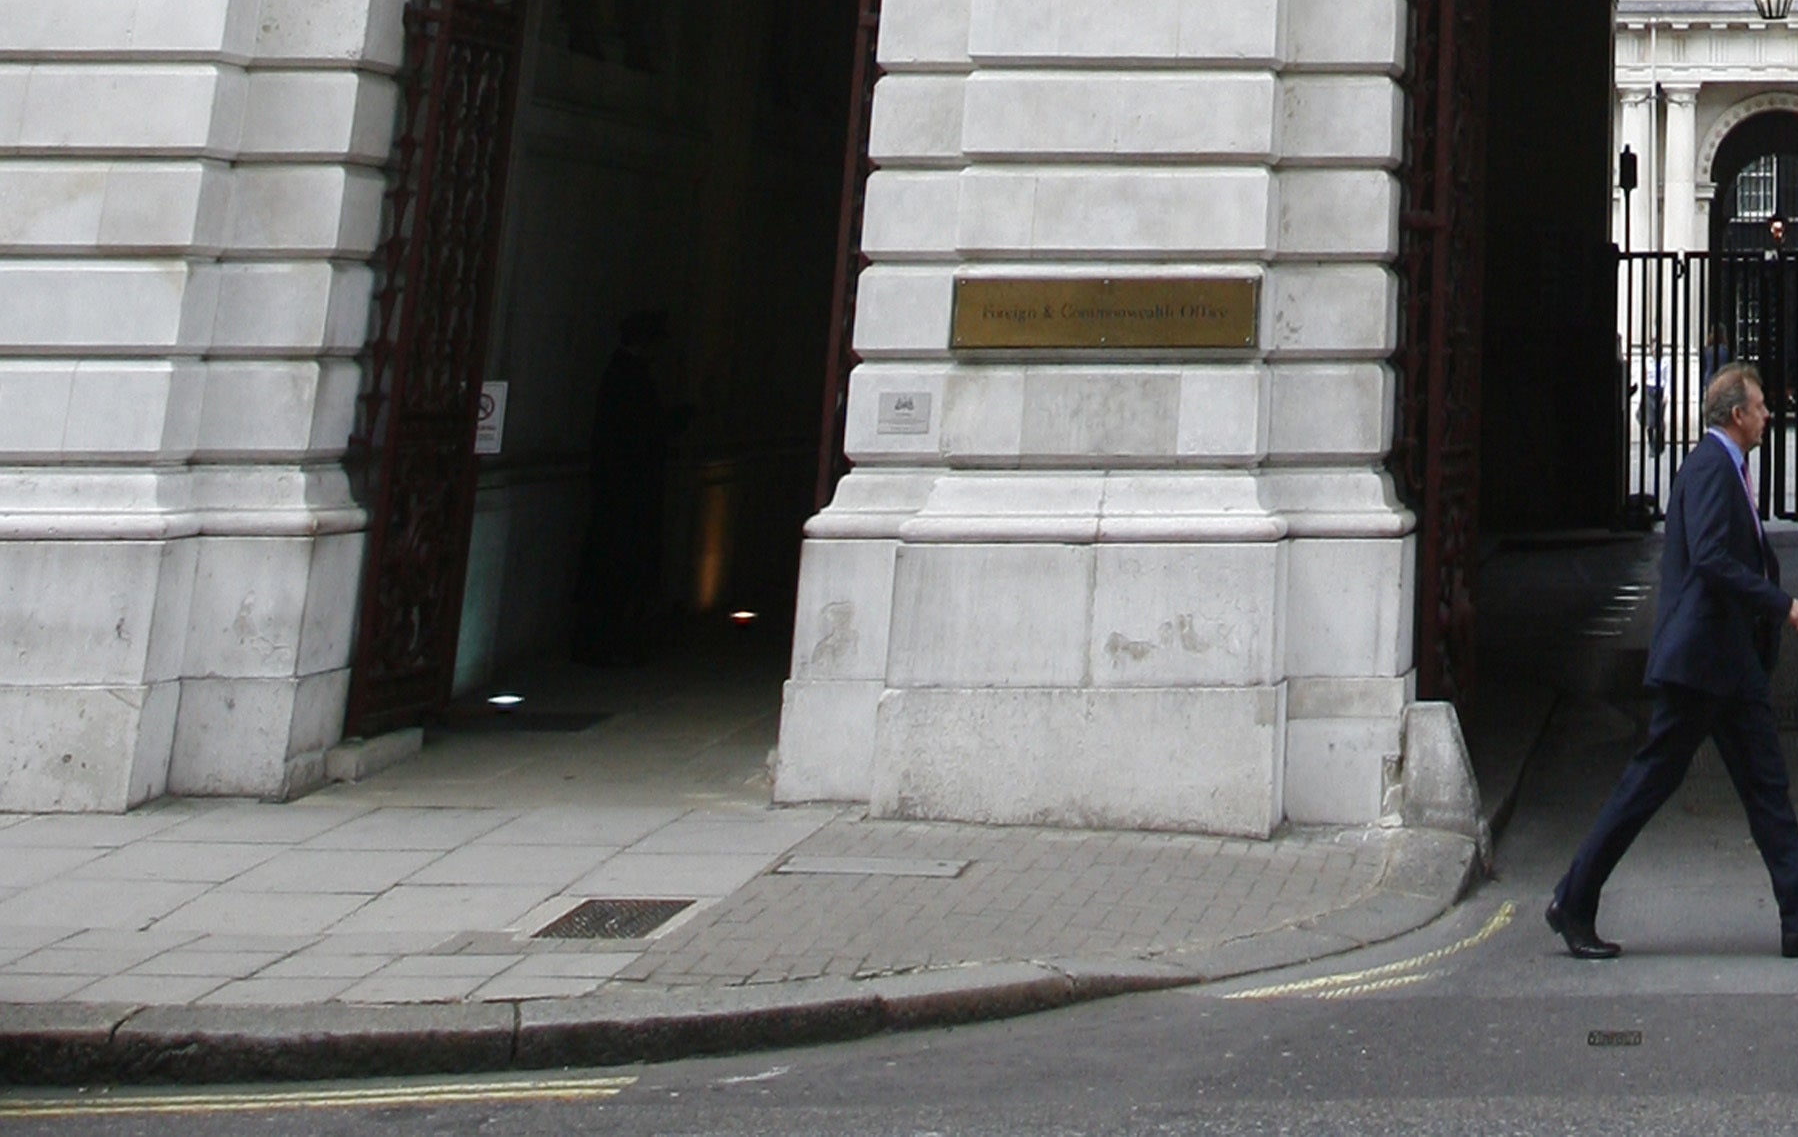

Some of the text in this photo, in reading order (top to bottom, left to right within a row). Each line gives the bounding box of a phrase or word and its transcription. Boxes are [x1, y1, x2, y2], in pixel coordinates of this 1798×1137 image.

[982, 303, 1228, 322] Foreign & Commonwealth Office
